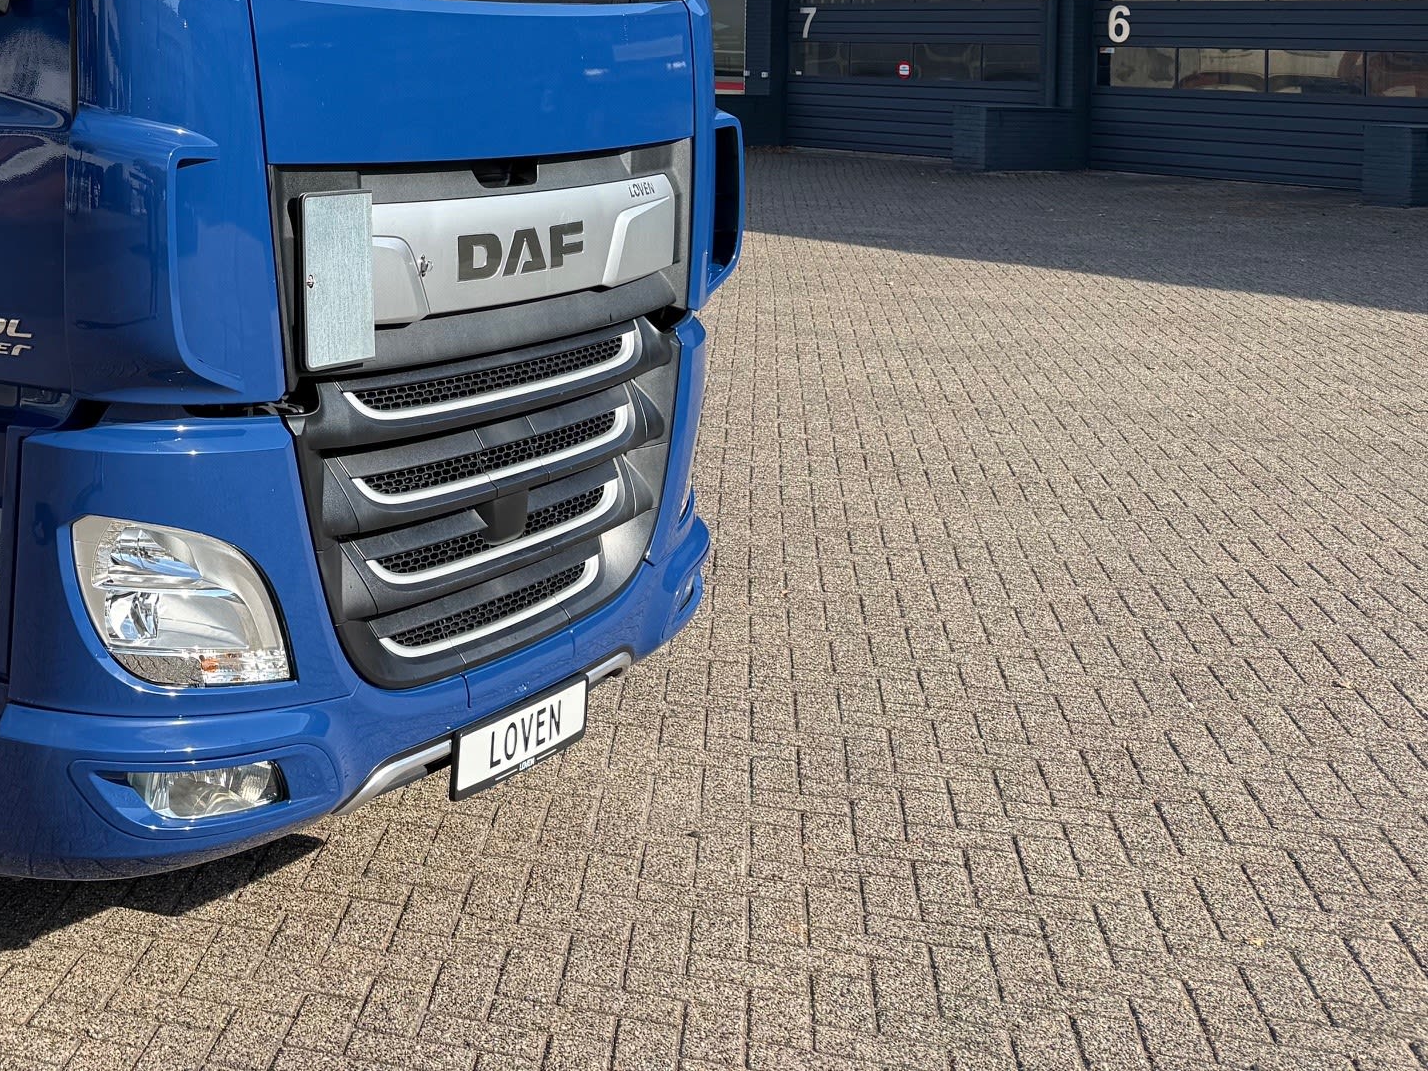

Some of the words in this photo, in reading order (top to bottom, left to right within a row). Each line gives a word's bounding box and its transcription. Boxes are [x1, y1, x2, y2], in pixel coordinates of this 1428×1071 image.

[799, 7, 817, 39] 7
[1108, 5, 1131, 43] 6
[628, 181, 656, 198] LOVEN
[457, 220, 584, 283] DAF
[489, 699, 562, 769] LOVEN
